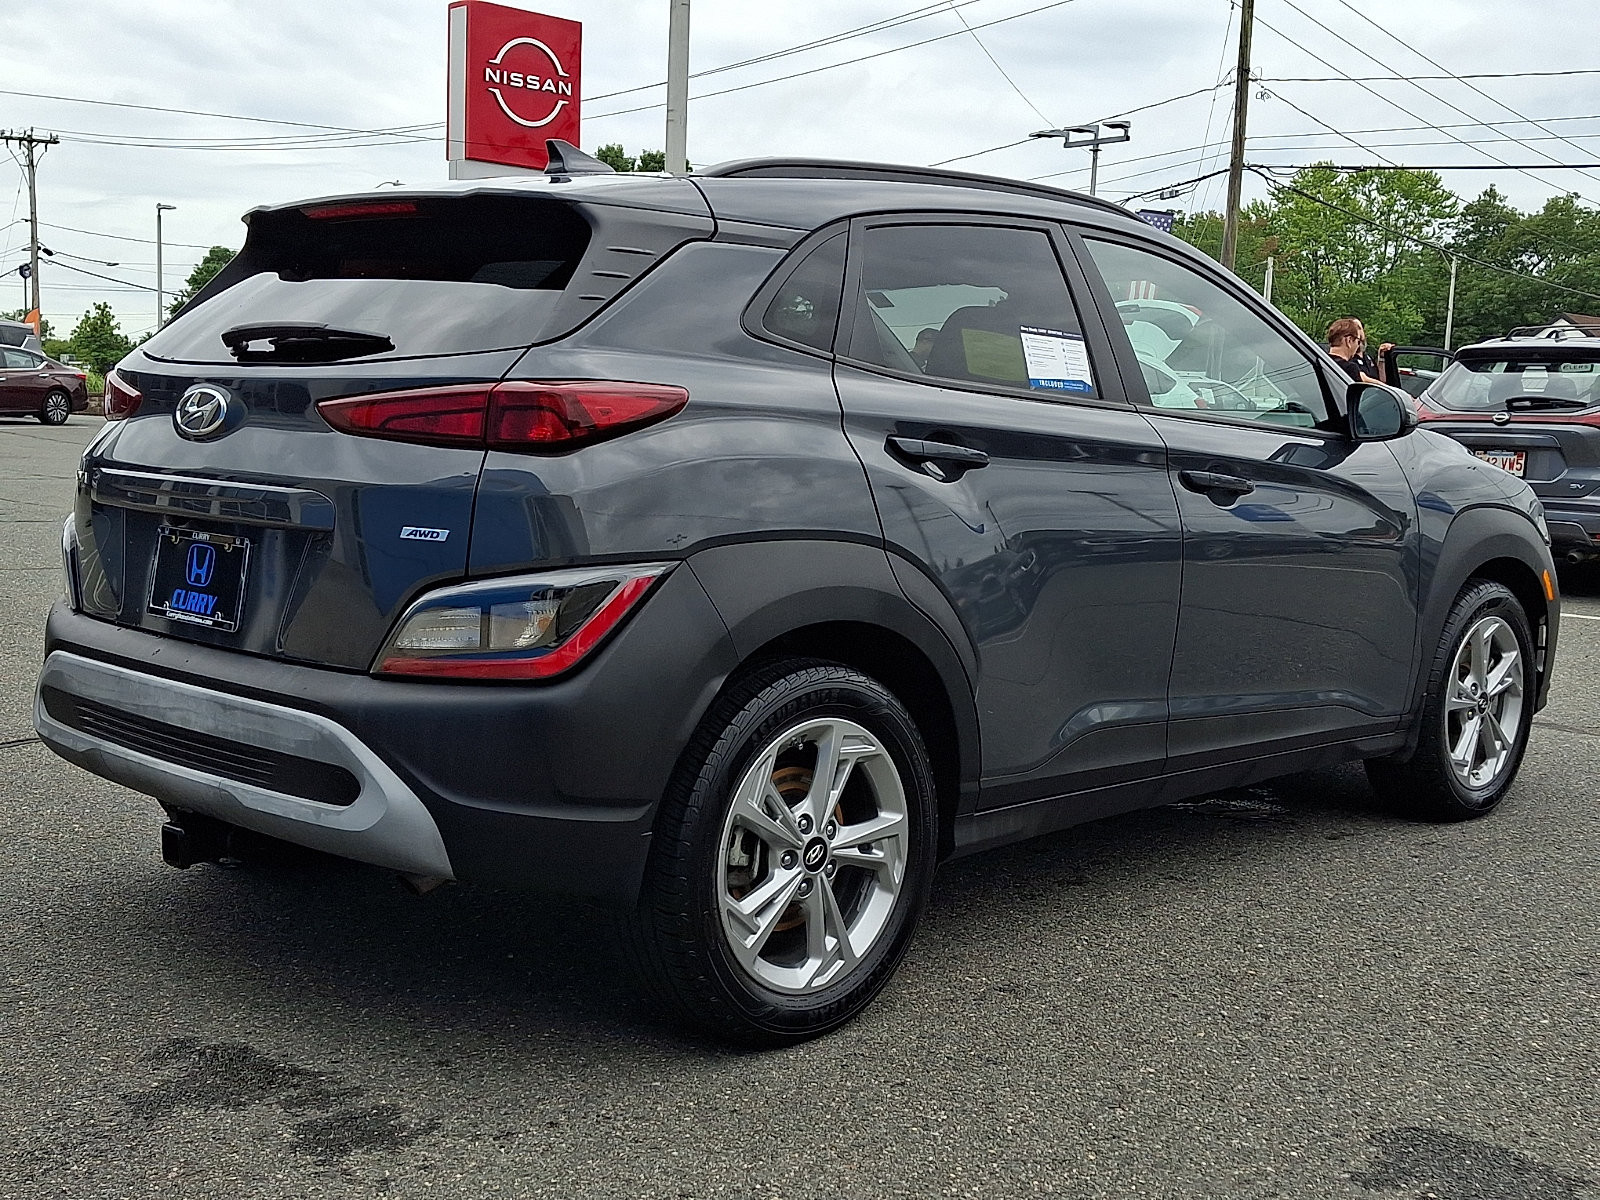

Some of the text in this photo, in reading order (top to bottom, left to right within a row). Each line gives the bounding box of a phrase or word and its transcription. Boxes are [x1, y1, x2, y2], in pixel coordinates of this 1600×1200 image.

[485, 67, 572, 96] NISSAN
[192, 532, 210, 541] CURRY
[406, 530, 440, 539] AWD
[171, 589, 217, 615] CURRY
